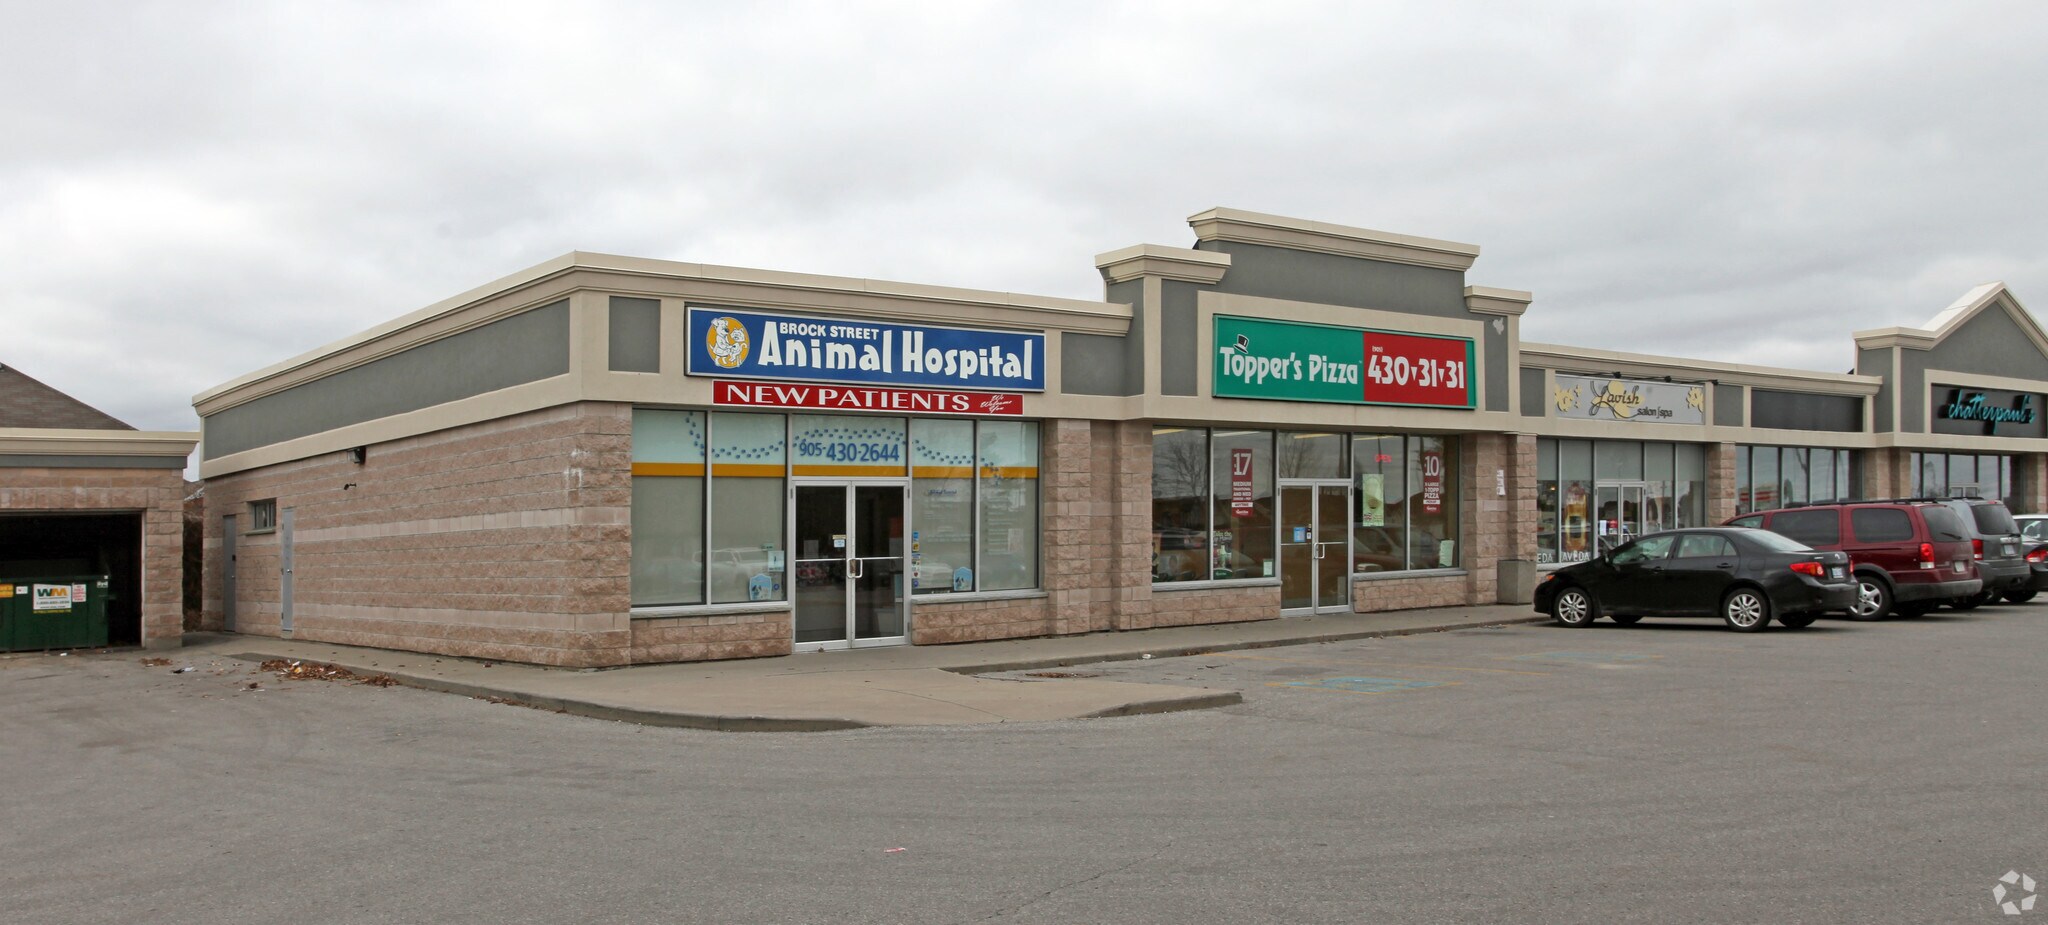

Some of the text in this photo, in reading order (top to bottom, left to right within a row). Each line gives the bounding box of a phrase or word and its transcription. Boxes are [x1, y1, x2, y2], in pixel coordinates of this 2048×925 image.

[780, 322, 879, 340] BROCK STREET
[757, 320, 1032, 380] Animal Hospital
[1219, 346, 1303, 385] Topper's
[1308, 353, 1358, 385] Pizza
[727, 384, 970, 411] NEW PATIENTS
[1589, 380, 1640, 416] Lavish
[1949, 389, 2036, 435] chatterpaul's
[798, 441, 899, 462] 905-430-2644
[1536, 550, 1591, 563] EDA AVEDA
[37, 587, 69, 597] WM
